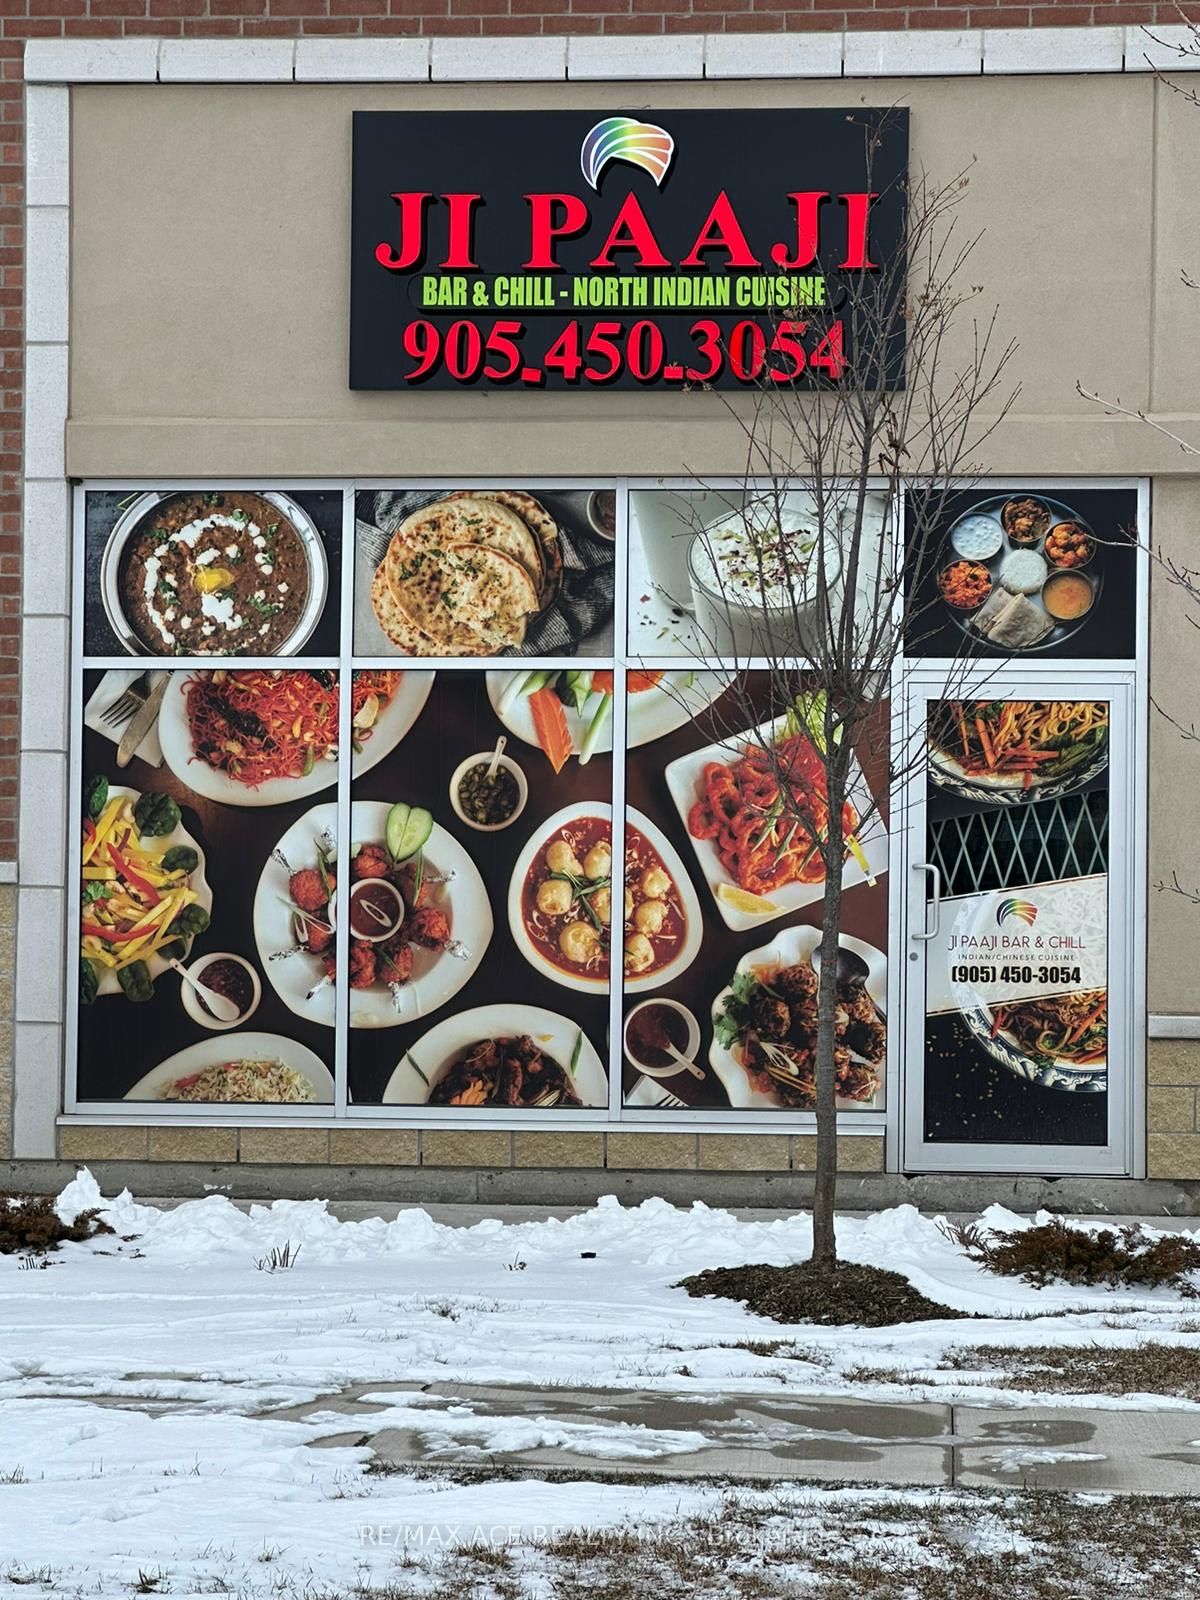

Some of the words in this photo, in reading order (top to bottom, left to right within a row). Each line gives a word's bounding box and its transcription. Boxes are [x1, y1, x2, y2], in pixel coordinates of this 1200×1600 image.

[375, 193, 482, 269] JI
[521, 189, 880, 270] PAAJI
[423, 276, 468, 306] BAR
[472, 281, 489, 306] &
[494, 276, 555, 307] CHILL
[573, 276, 648, 307] NORTH
[653, 276, 730, 306] INDIAN
[736, 276, 826, 307] CUISINE
[948, 935, 958, 951] JI
[961, 935, 998, 951] PAAJI
[1002, 936, 1030, 948] BAR
[1034, 936, 1044, 948] &
[1048, 936, 1086, 949] CHILL
[952, 965, 997, 983] (905)
[1000, 966, 1081, 983] 450-3054
